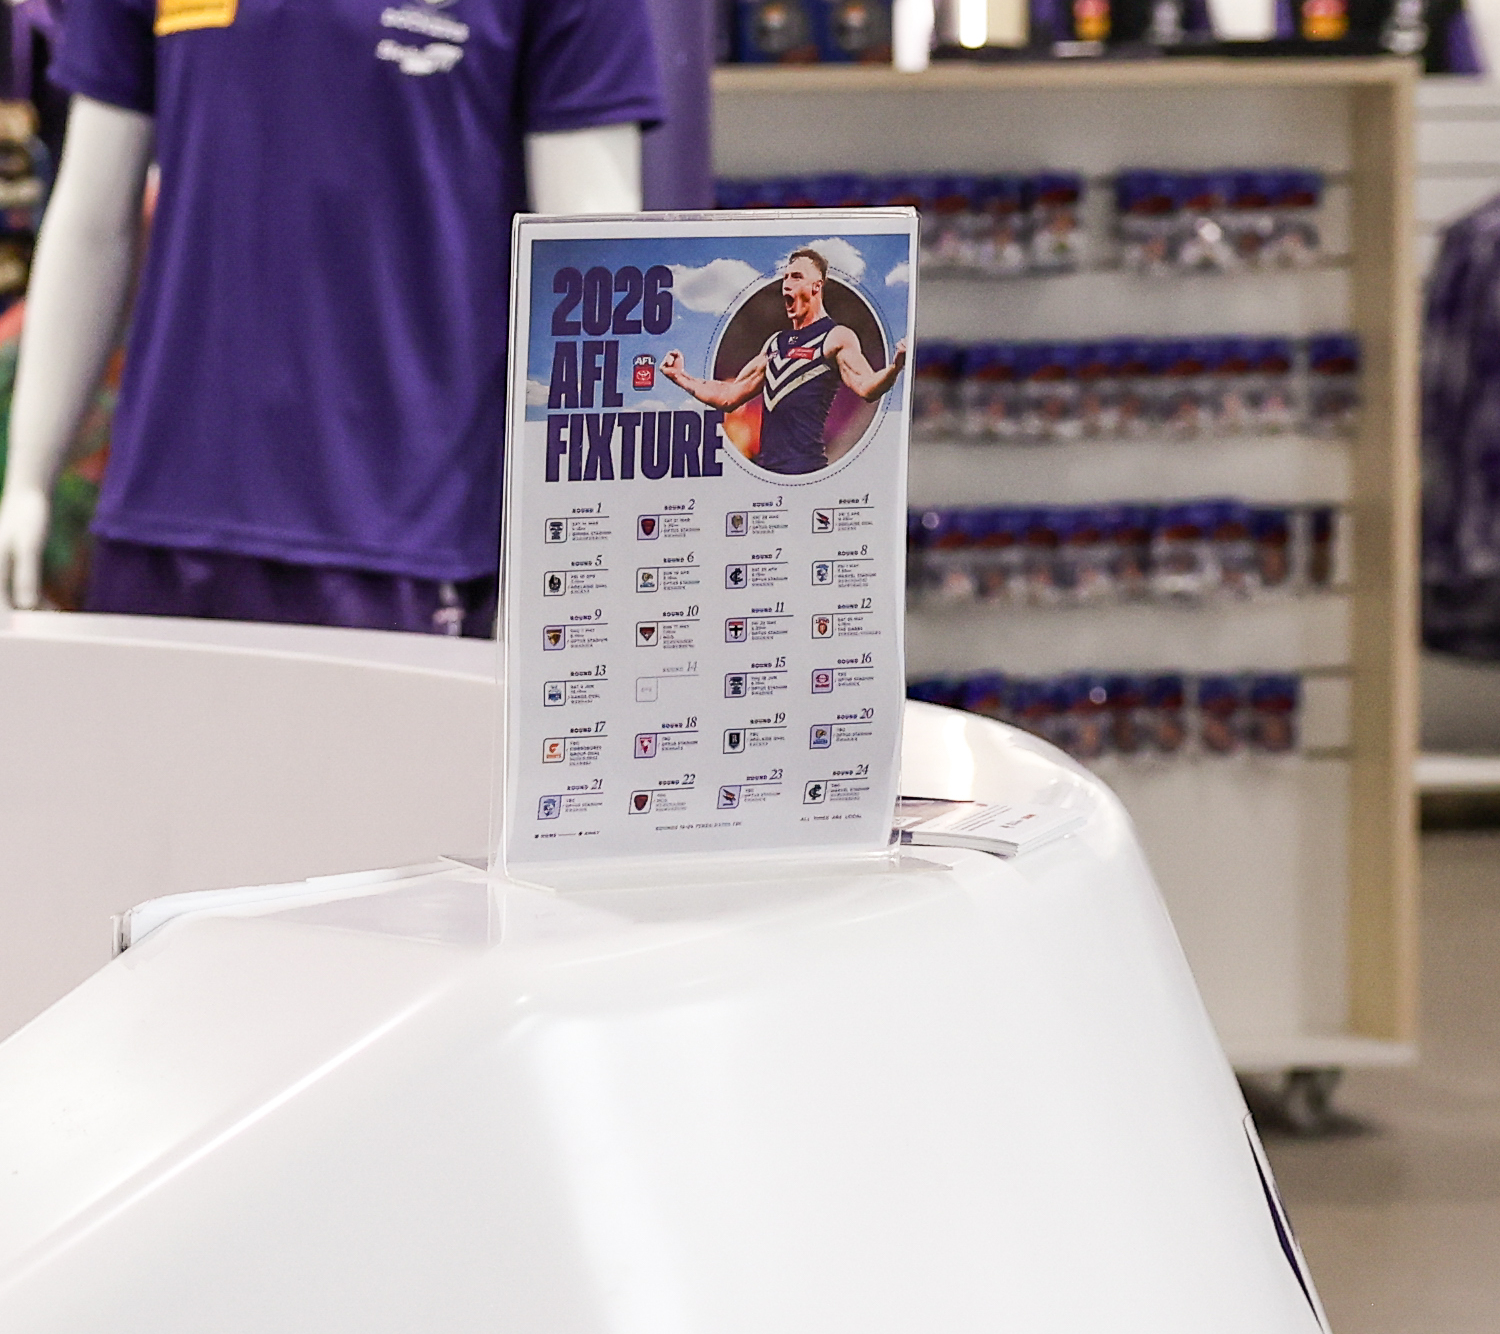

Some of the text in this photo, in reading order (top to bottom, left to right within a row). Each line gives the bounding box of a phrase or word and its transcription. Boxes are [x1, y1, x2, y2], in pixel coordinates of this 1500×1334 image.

[551, 265, 674, 336] 2026
[634, 356, 656, 365] AFL
[547, 340, 624, 409] AFL
[545, 410, 724, 483] FIXTURE
[688, 499, 696, 510] 2
[776, 496, 783, 507] 3
[597, 502, 602, 513] 1
[776, 548, 783, 559] 7
[860, 545, 869, 555] 8
[595, 555, 603, 566] 5
[687, 552, 695, 562] 6
[775, 602, 785, 612] 11
[861, 598, 872, 608] 12
[595, 609, 602, 620] 9
[687, 605, 700, 616] 10
[775, 657, 787, 668] 15
[861, 652, 872, 664] 16
[595, 665, 607, 676] 13
[774, 712, 786, 723] 19
[860, 708, 875, 719] 20
[595, 721, 607, 732] 17
[685, 717, 698, 728] 18
[769, 769, 784, 780] 23
[856, 764, 870, 775] 24
[591, 779, 604, 790] 21
[682, 774, 696, 785] 22
